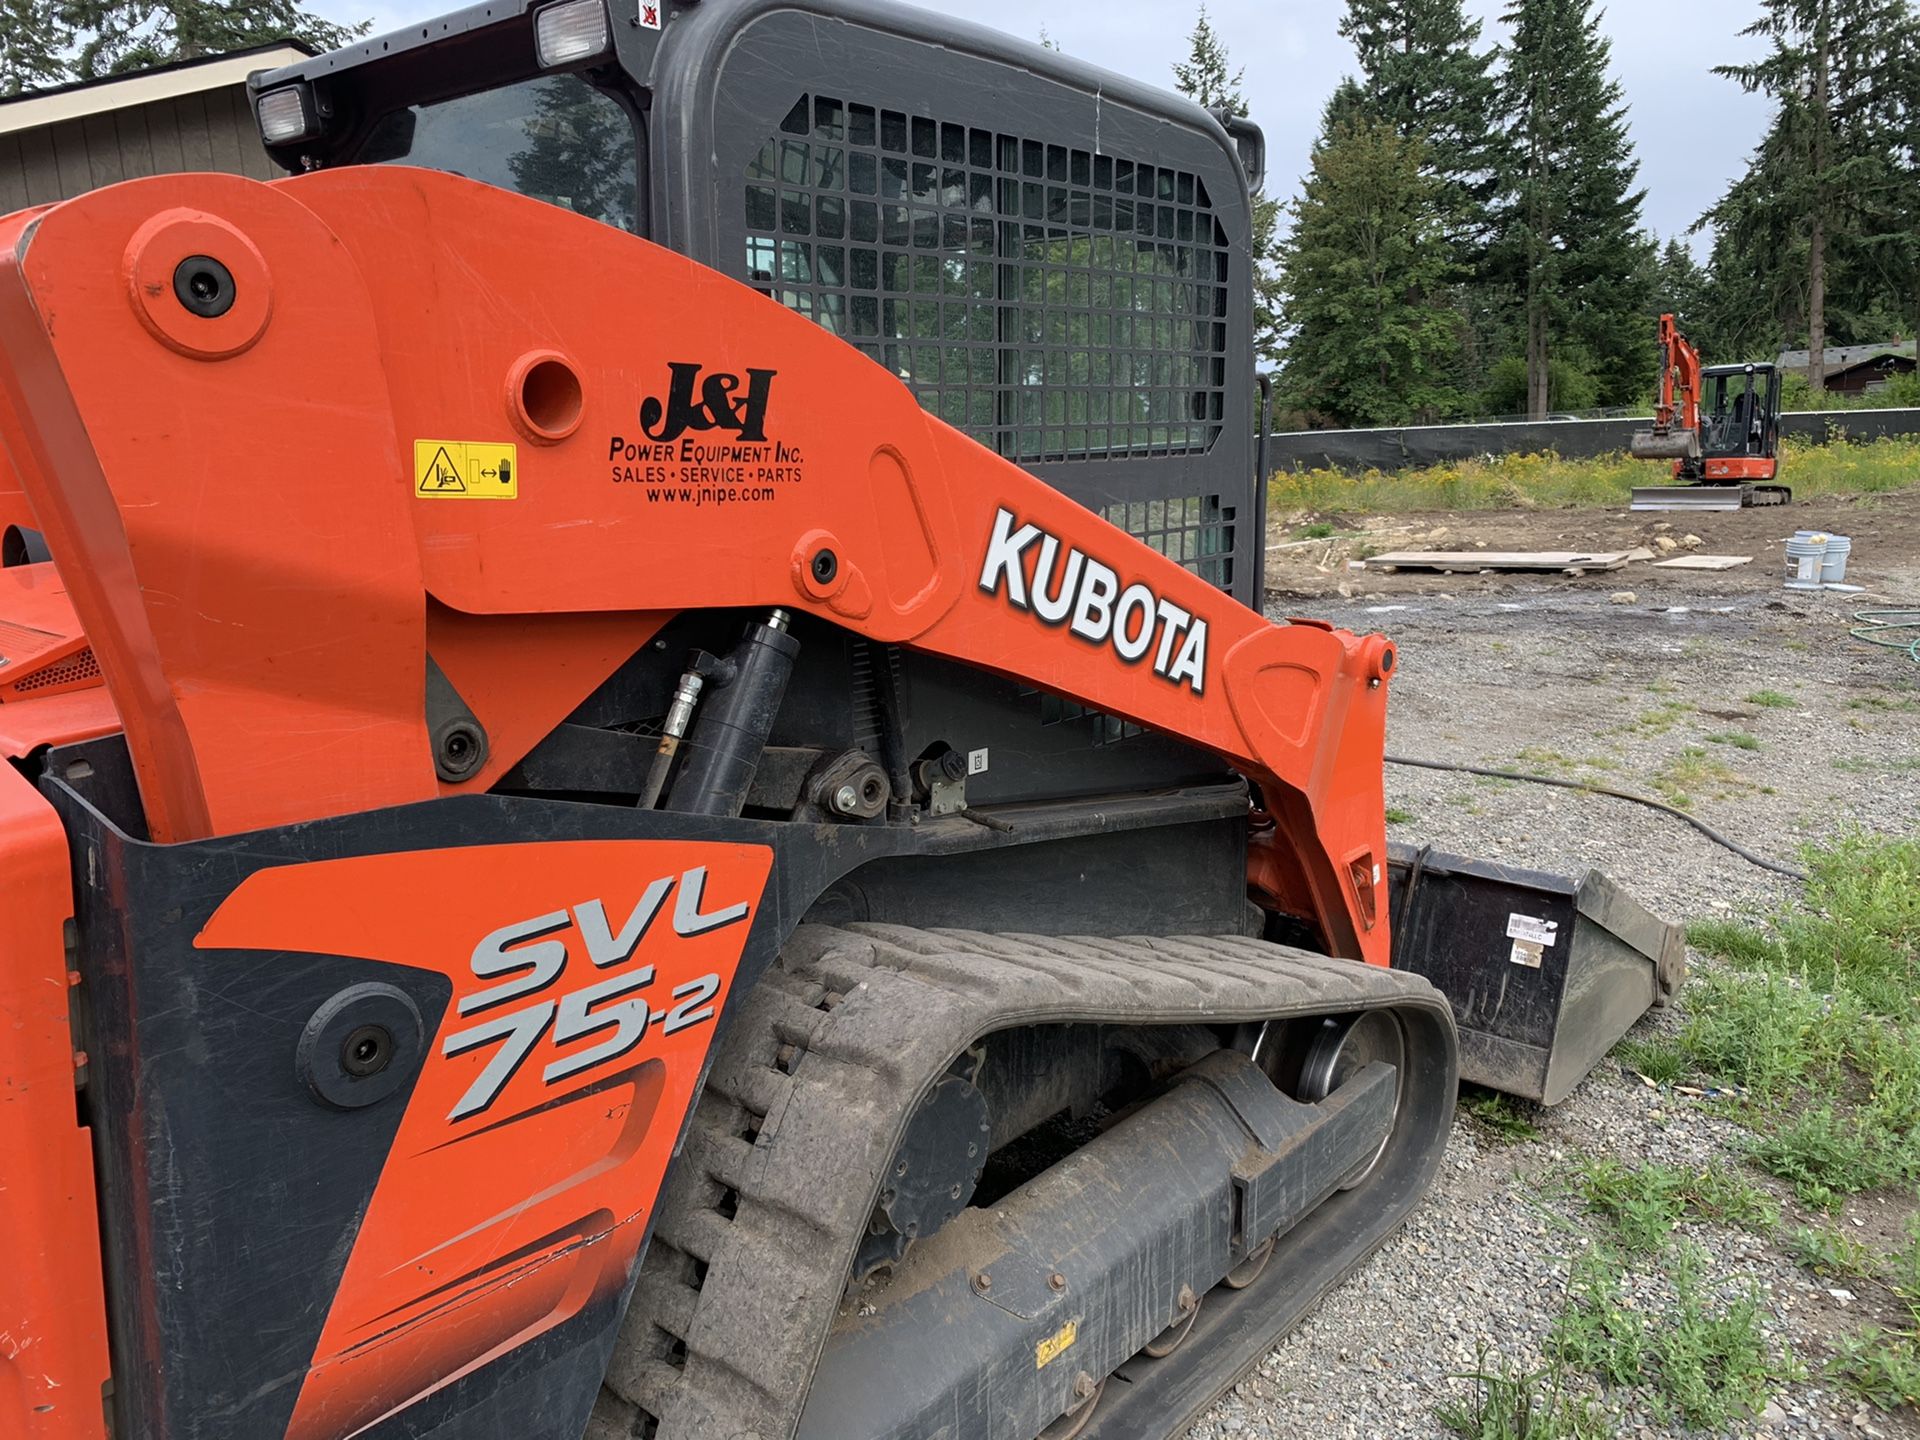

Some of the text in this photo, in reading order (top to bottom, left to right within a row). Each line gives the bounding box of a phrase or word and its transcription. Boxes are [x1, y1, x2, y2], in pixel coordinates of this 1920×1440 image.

[640, 361, 778, 442] J&I
[612, 466, 802, 483] SALES SERVICE PARTS
[646, 484, 775, 507] www.jnipe.com
[979, 507, 1208, 694] KUBOTA
[457, 865, 749, 1018] SVL
[441, 963, 720, 1126] 75-2
